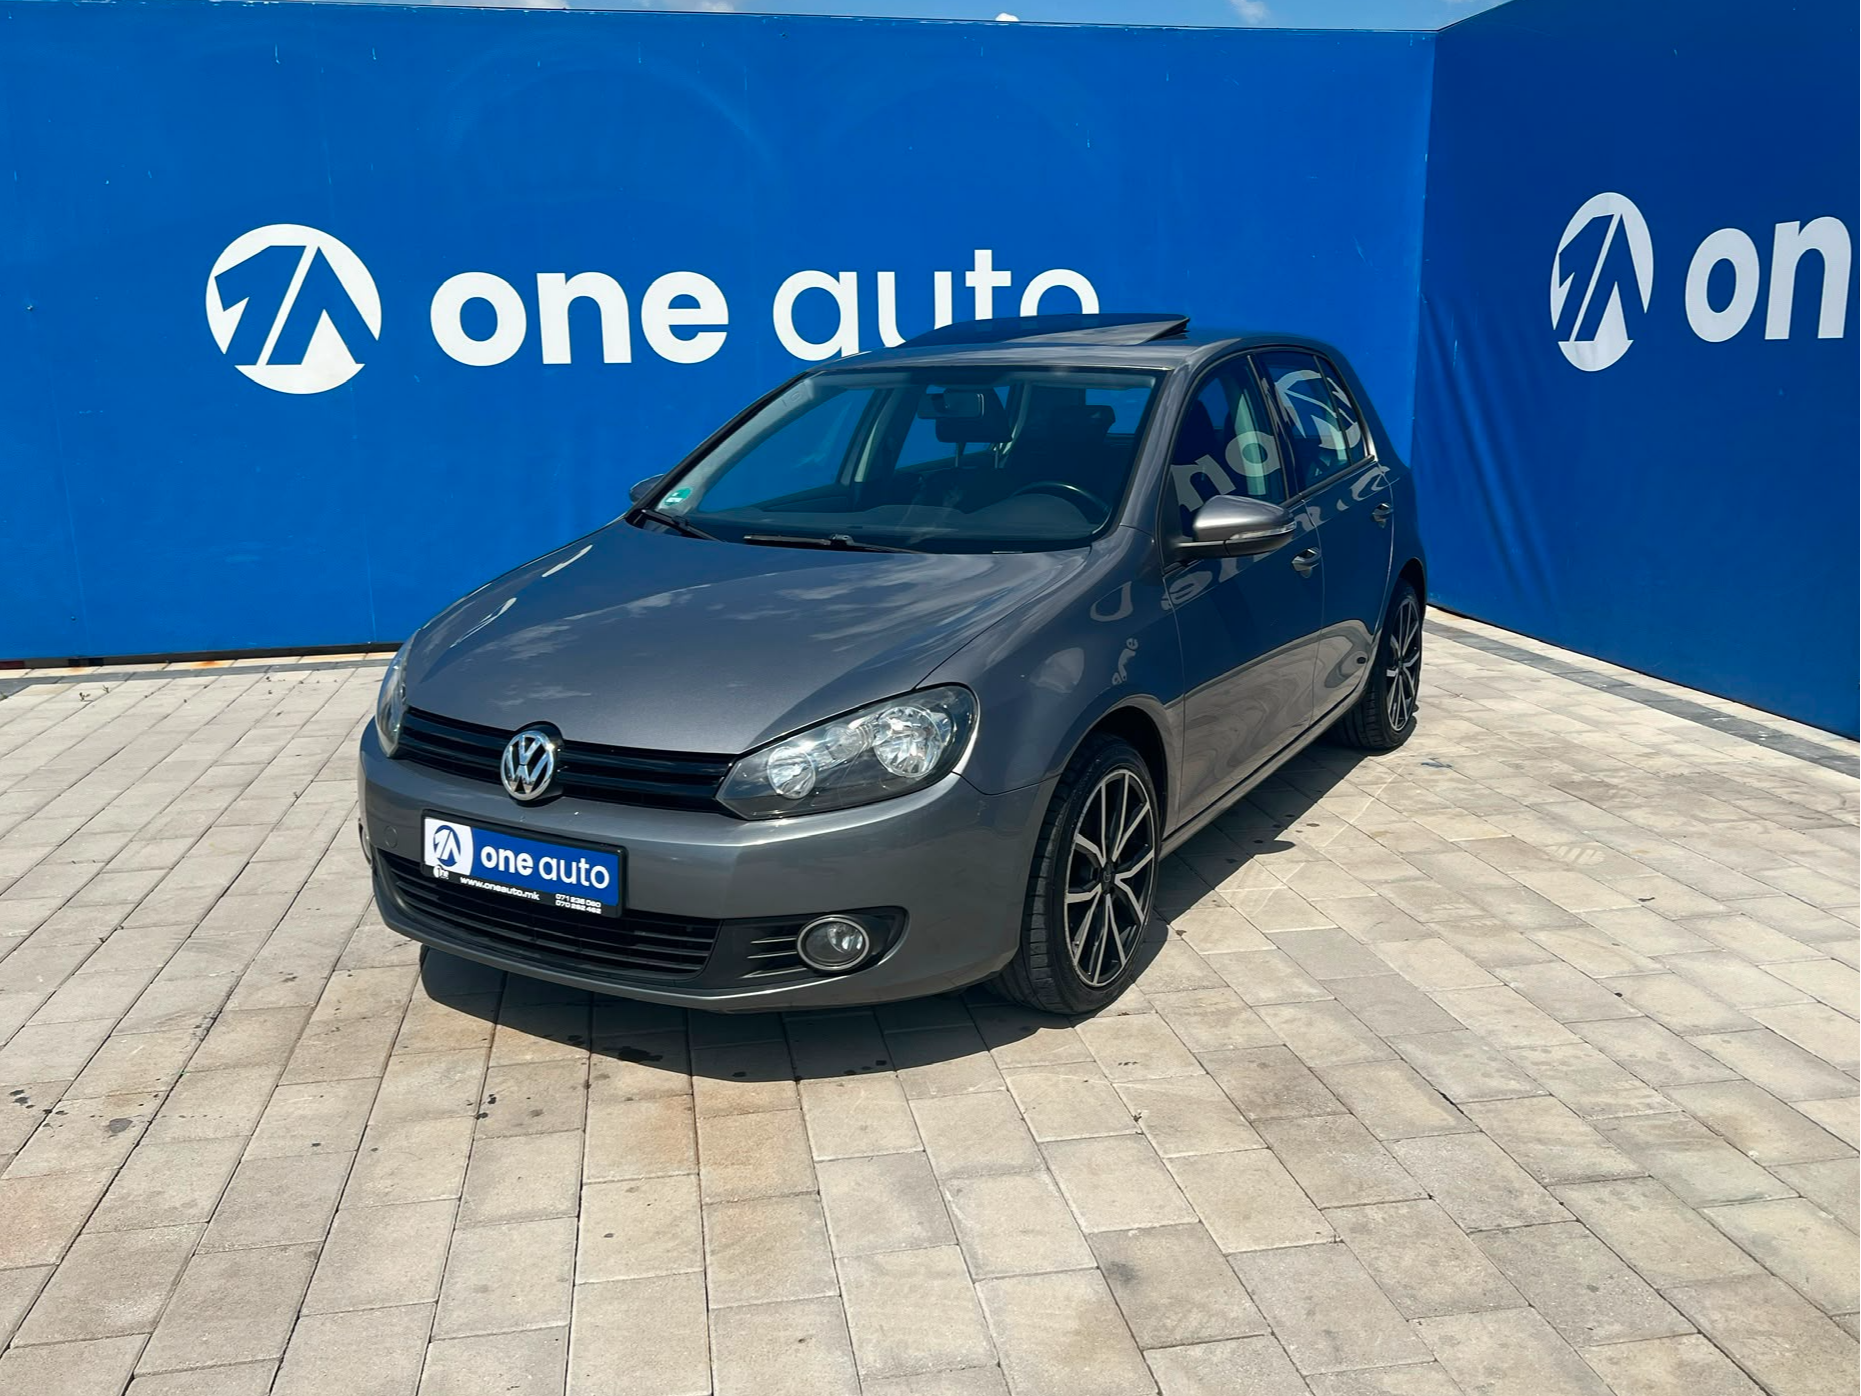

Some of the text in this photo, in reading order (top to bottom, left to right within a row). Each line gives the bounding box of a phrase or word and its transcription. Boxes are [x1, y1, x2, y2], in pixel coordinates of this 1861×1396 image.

[431, 249, 1100, 366] one auto
[459, 876, 540, 901] www.oneauto.mk
[480, 846, 534, 876] one
[538, 857, 610, 889] auto
